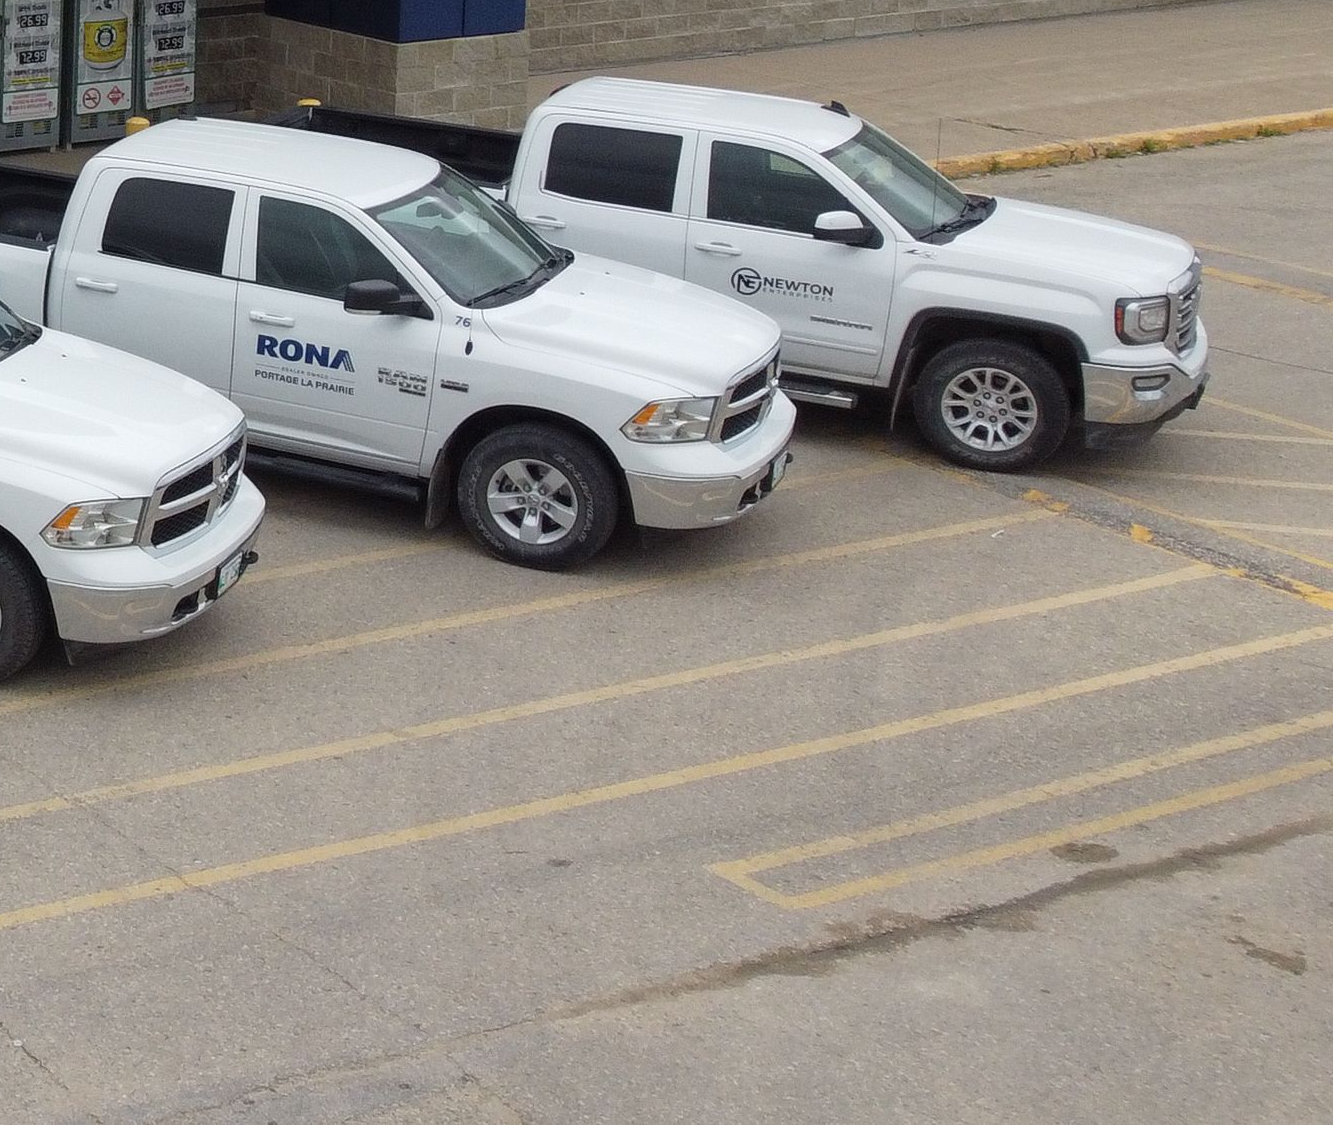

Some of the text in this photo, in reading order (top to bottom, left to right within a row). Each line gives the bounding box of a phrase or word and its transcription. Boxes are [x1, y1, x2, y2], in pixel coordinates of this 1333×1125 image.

[159, 2, 184, 15] 26.99
[20, 15, 48, 27] 26.99
[763, 276, 834, 297] NEWTON
[455, 315, 471, 328] 76
[256, 334, 355, 373] RONA
[254, 369, 355, 396] PORTAGE LA PRAIRIE
